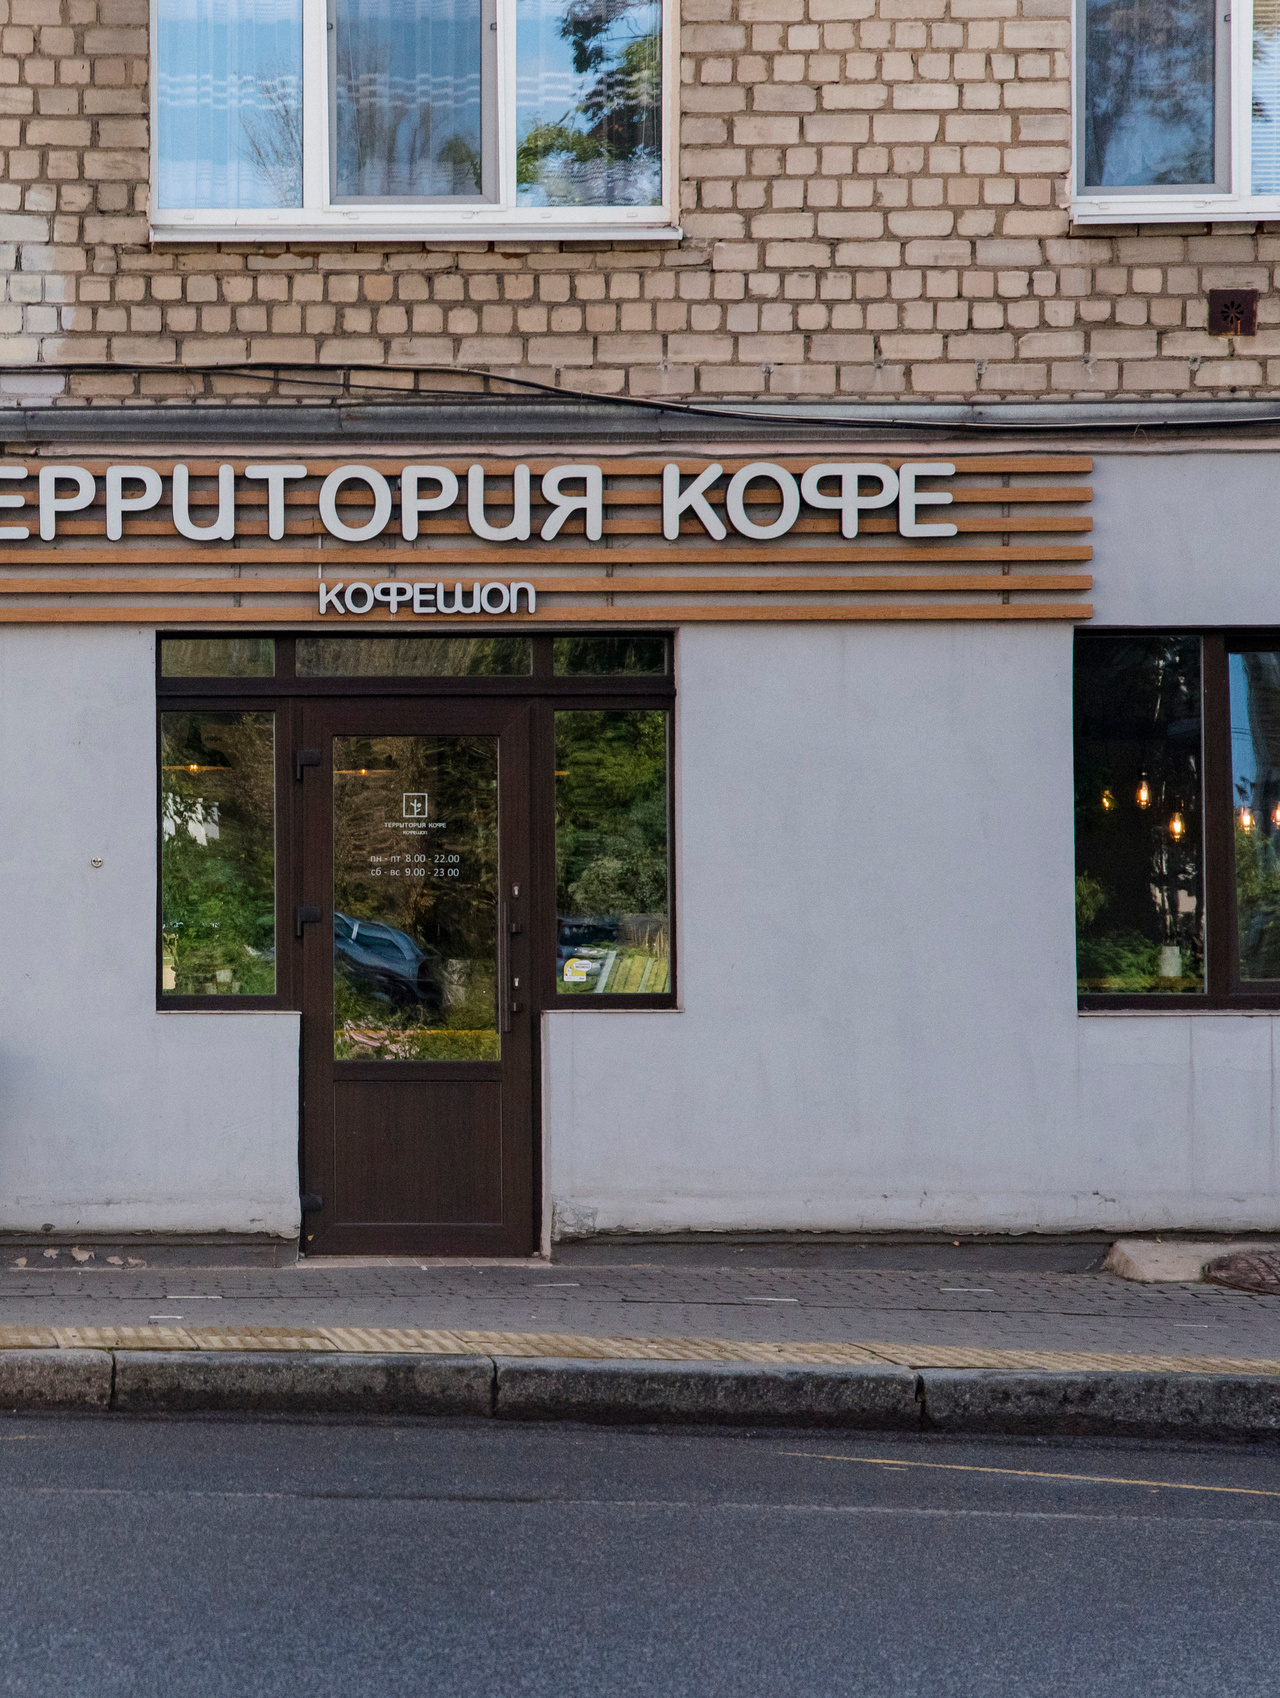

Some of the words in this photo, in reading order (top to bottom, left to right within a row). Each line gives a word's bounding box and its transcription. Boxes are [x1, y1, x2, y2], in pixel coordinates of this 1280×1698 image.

[662, 463, 959, 541] КОФЕ
[405, 854, 426, 863] 8.00
[434, 854, 460, 863] 22.00
[370, 867, 382, 876] сб
[404, 867, 426, 877] 9.00
